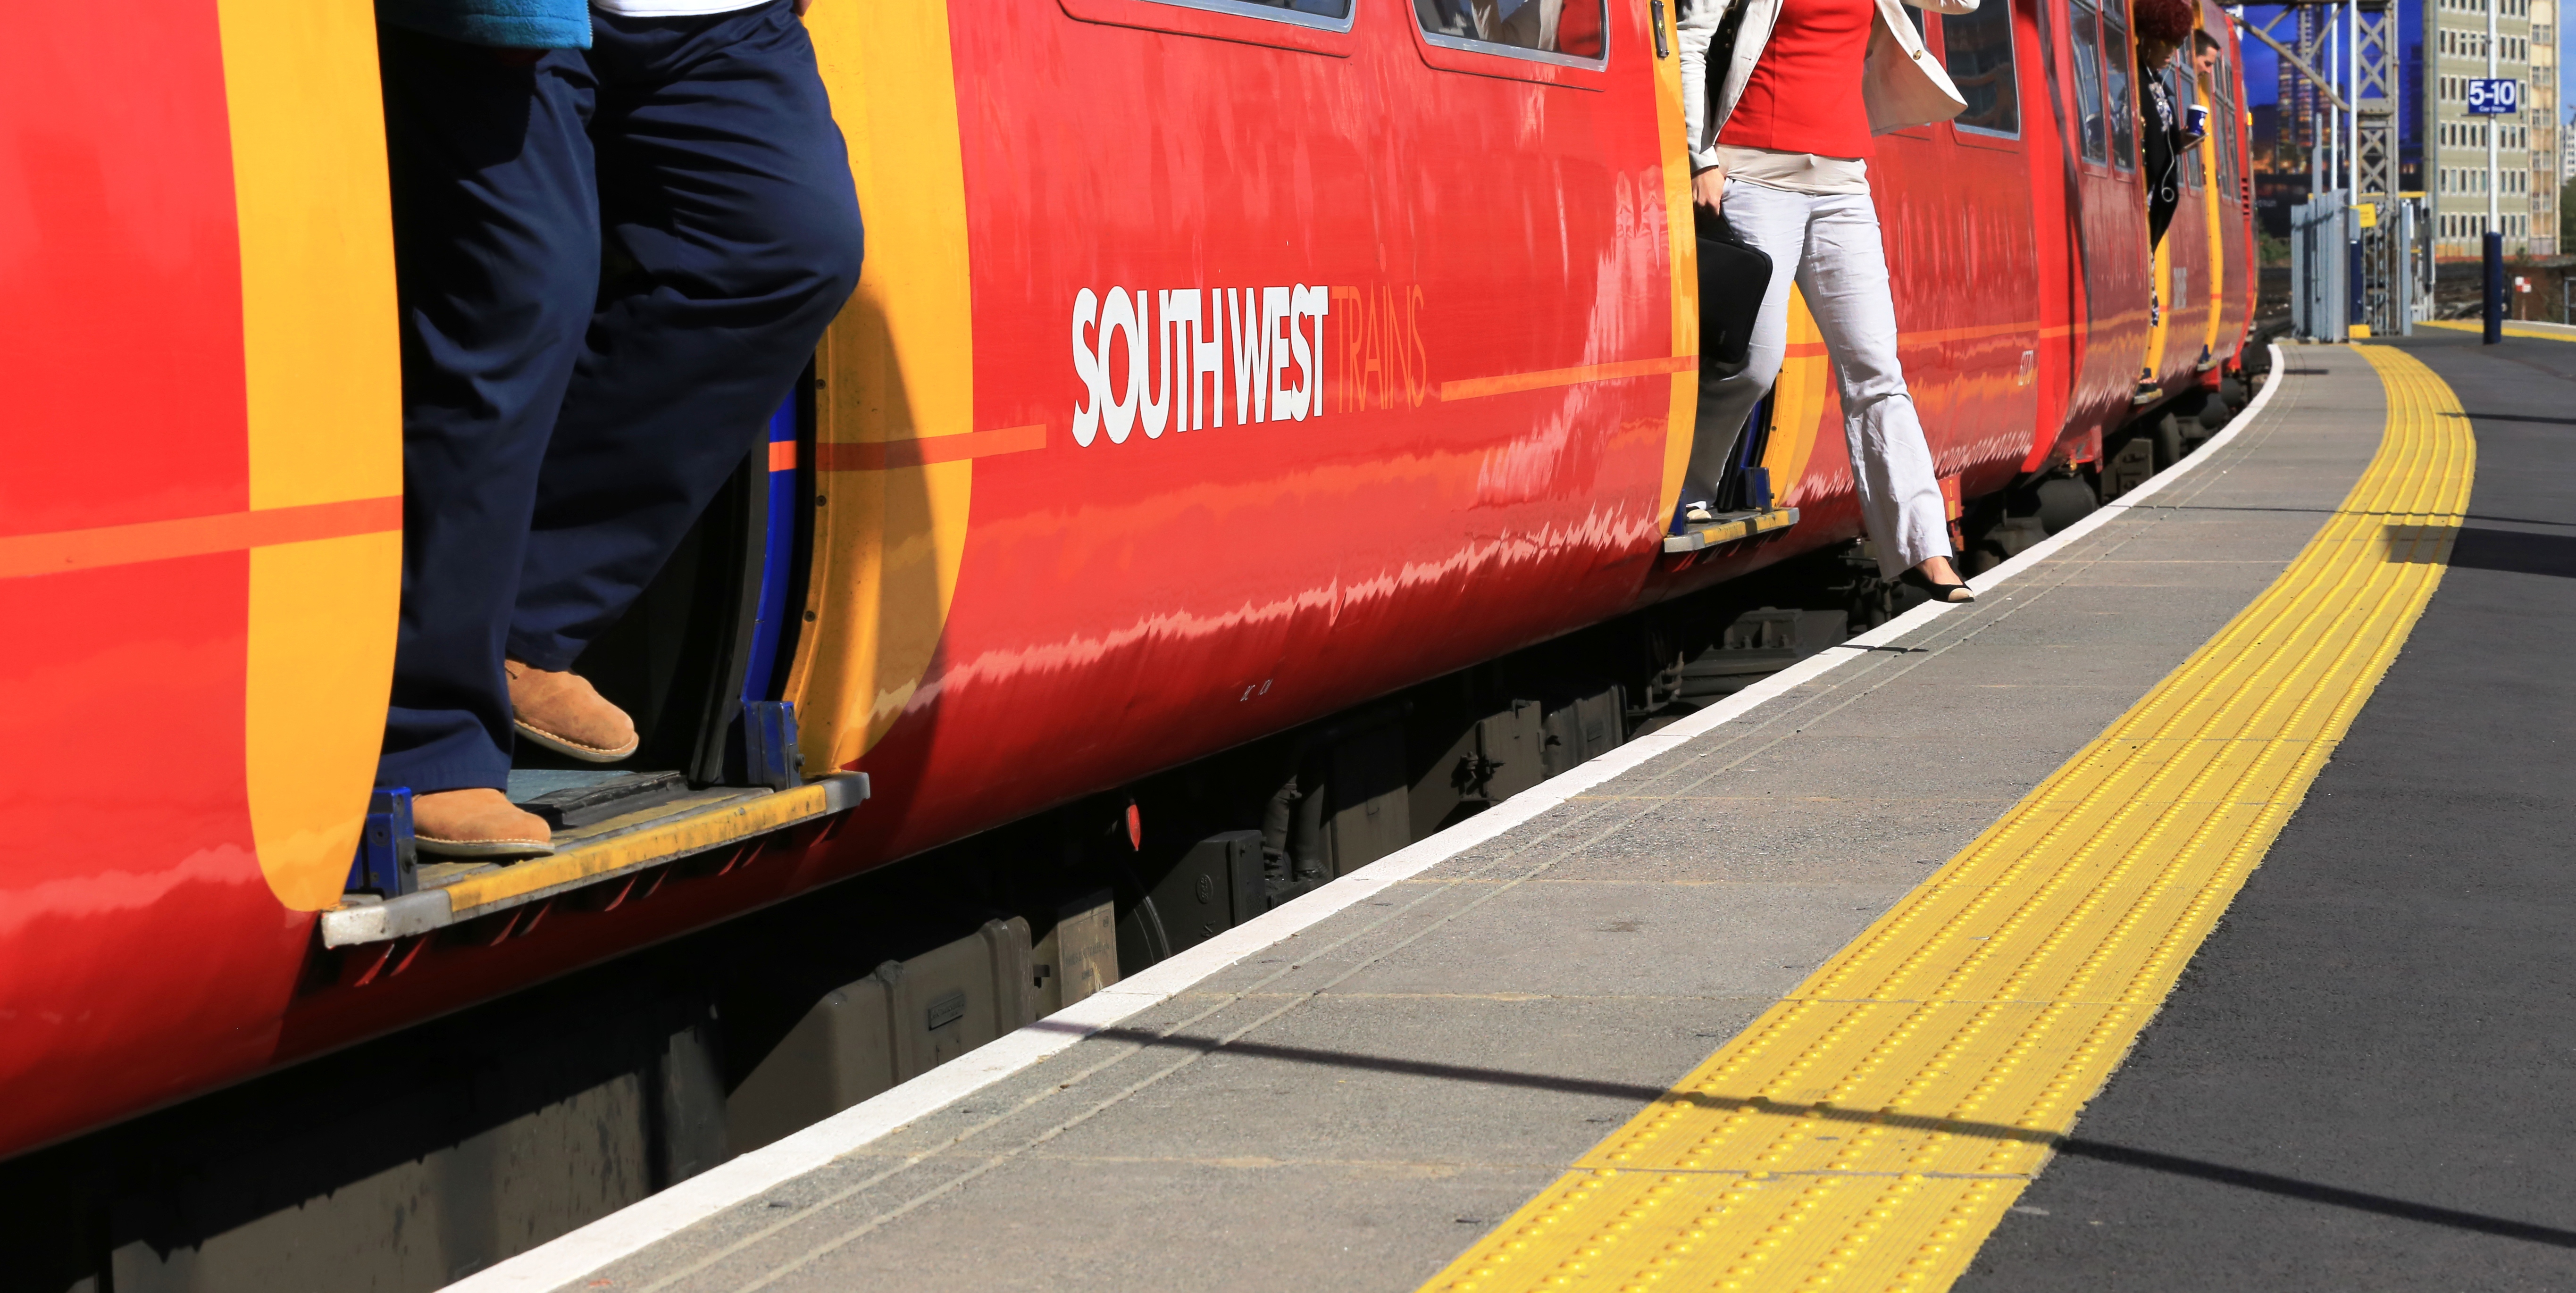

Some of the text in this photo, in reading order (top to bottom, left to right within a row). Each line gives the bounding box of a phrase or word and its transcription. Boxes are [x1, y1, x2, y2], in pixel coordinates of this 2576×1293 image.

[2469, 81, 2515, 106] 5-10
[1072, 280, 1426, 448] SOUTH WEST TRAINS
